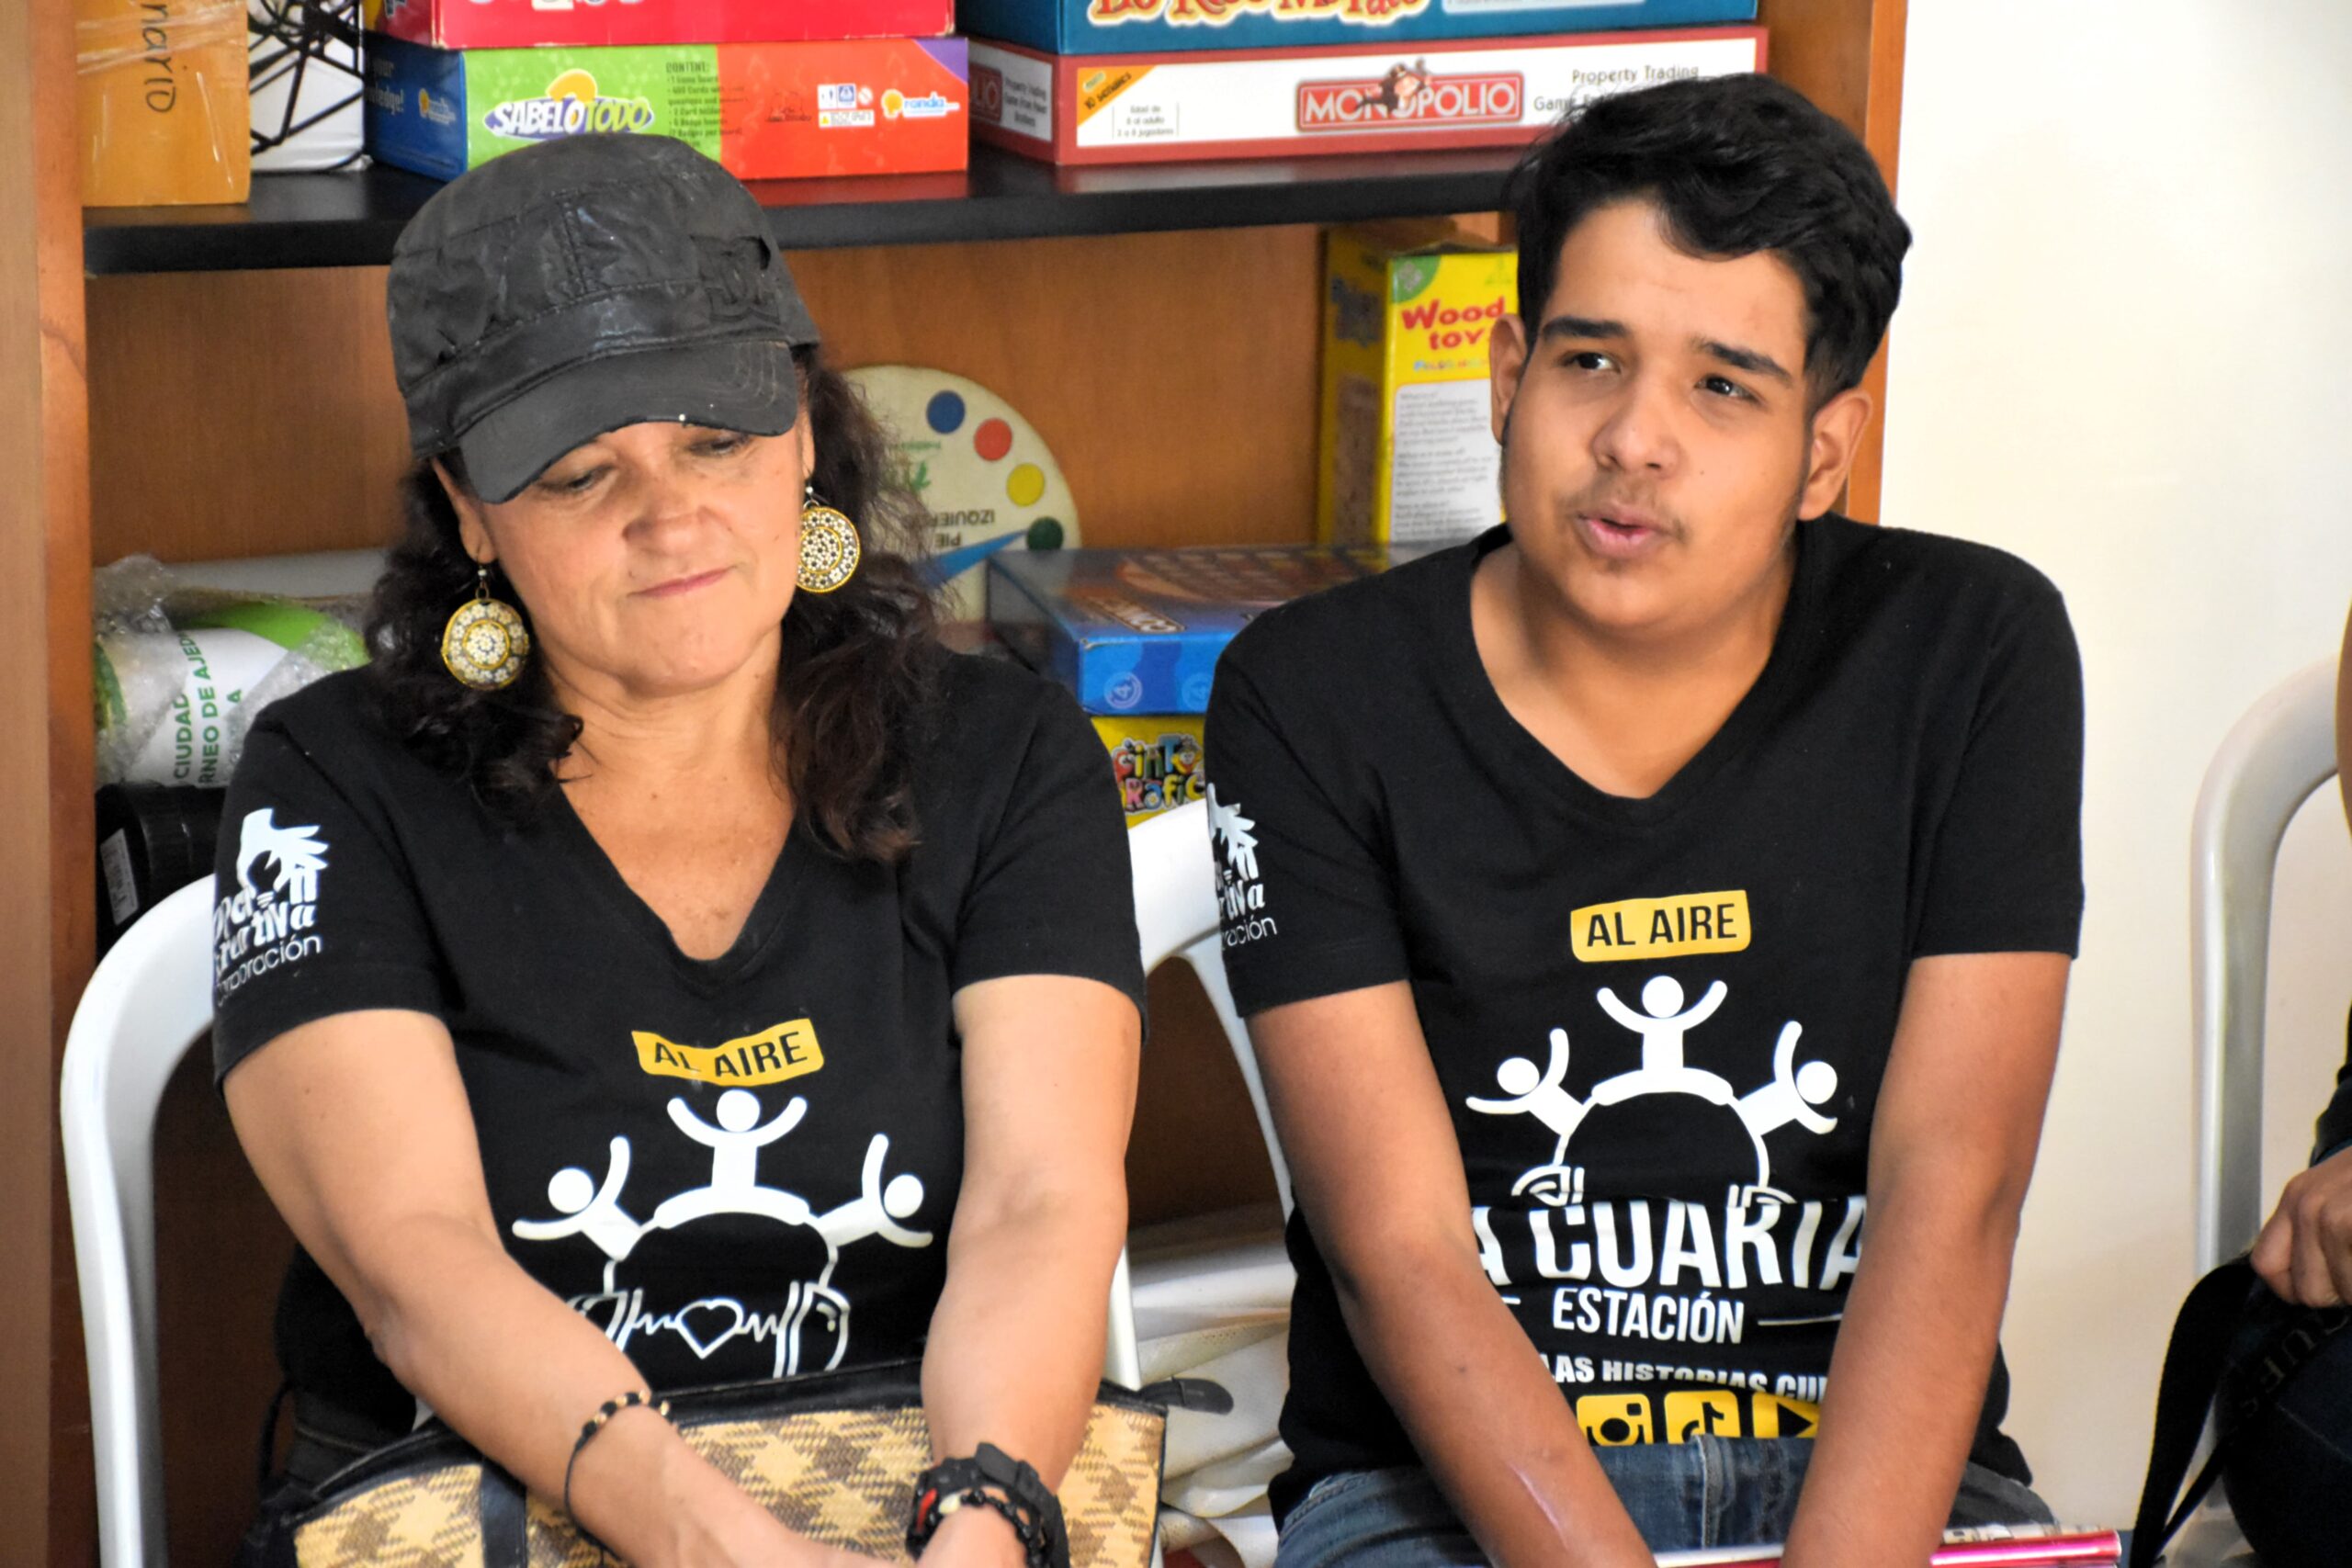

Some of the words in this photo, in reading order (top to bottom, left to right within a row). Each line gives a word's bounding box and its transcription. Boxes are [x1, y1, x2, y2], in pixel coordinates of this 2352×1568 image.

[1572, 68, 1637, 85] Property
[1644, 65, 1699, 81] Trading
[1401, 297, 1507, 331] Wood
[197, 686, 219, 718] DE
[1587, 912, 1636, 947] AL
[1649, 903, 1738, 945] AIRE
[653, 1042, 702, 1073] AL
[714, 1031, 808, 1077] AIRE
[1528, 1194, 1867, 1291] CUARIA
[1552, 1286, 1745, 1345] ESTACIÓN
[1602, 1359, 1769, 1393] HISTORIAS
